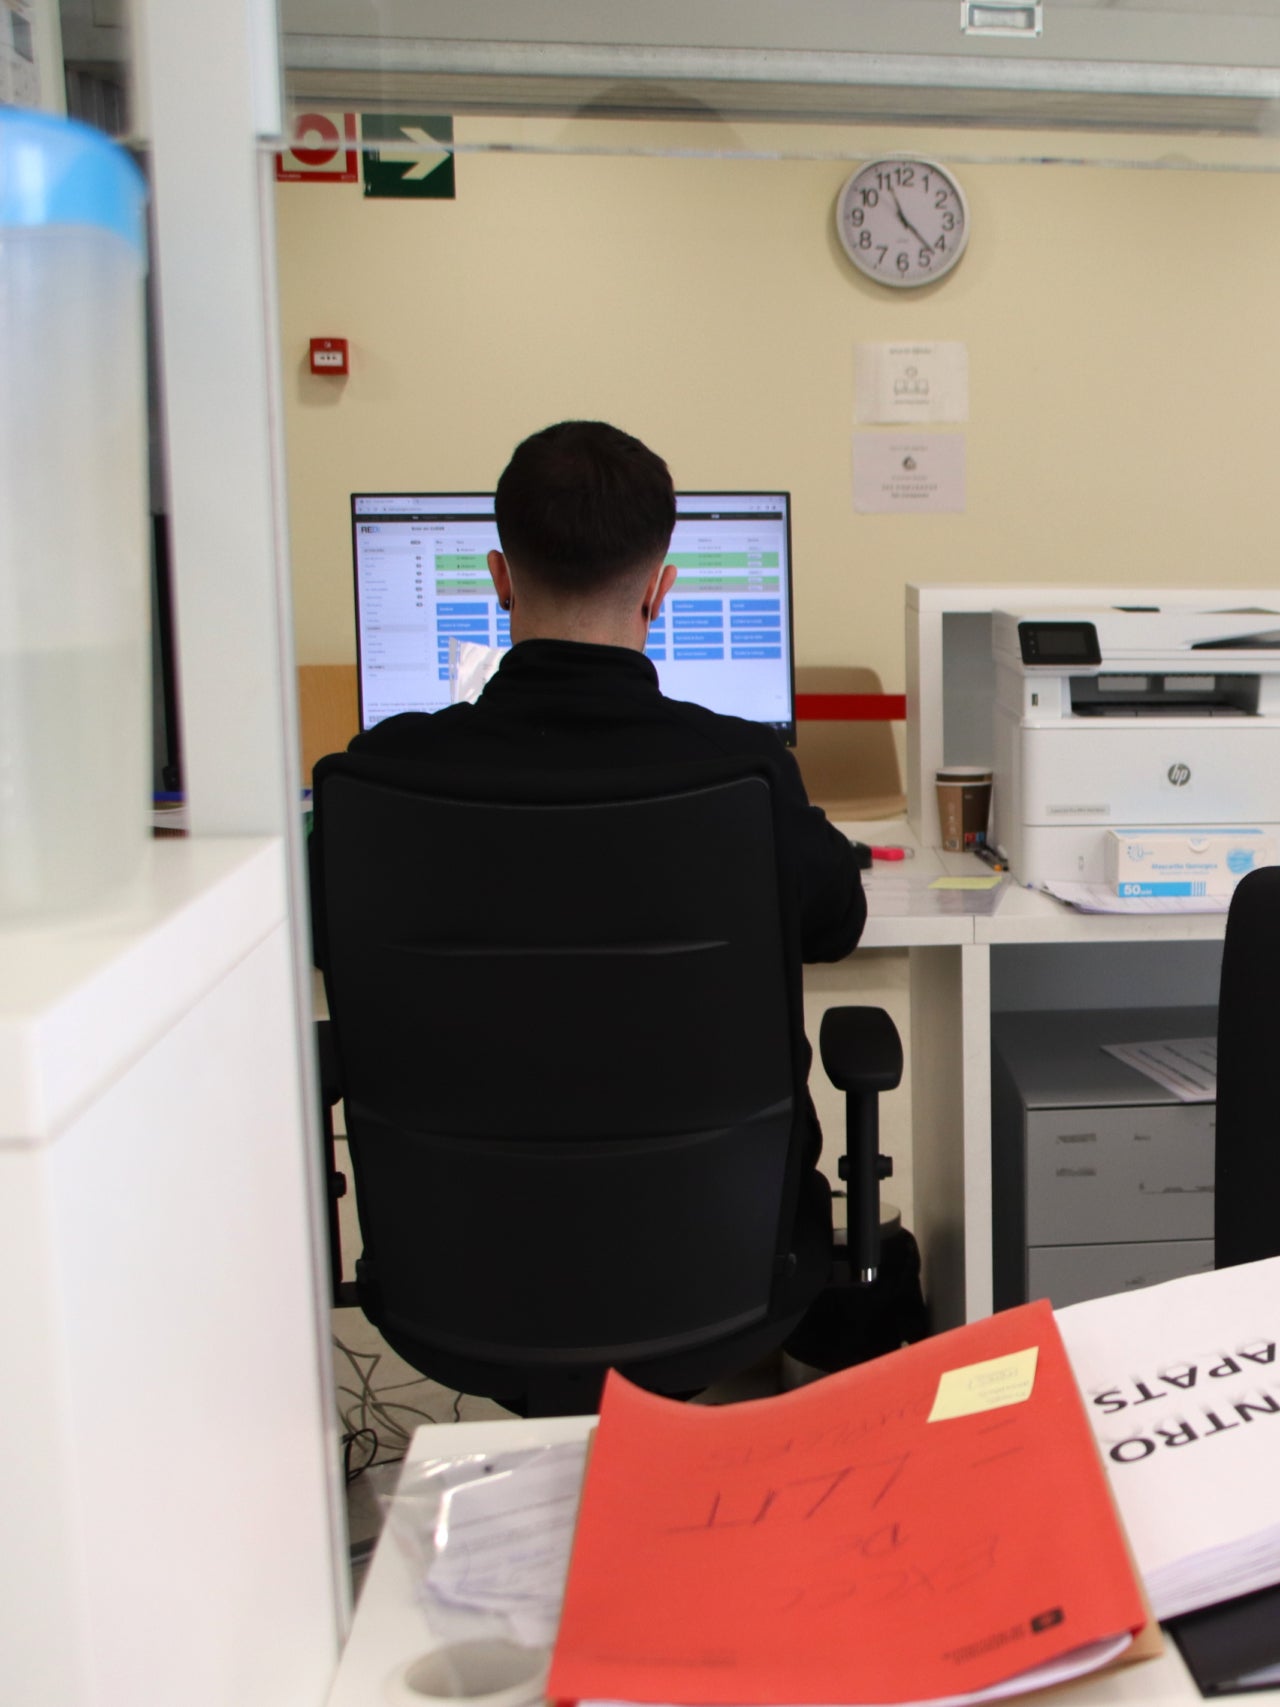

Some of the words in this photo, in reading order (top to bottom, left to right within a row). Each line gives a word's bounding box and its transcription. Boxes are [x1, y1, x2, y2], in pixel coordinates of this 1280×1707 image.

[876, 172, 891, 191] 11
[894, 167, 915, 187] 12
[922, 174, 930, 193] 1
[859, 188, 879, 208] 10
[935, 189, 948, 209] 2
[851, 208, 865, 228] 9
[941, 211, 955, 231] 3
[859, 230, 872, 250] 8
[934, 234, 946, 252] 4
[875, 245, 889, 264] 7
[896, 252, 910, 272] 6
[917, 247, 931, 268] 5
[1168, 763, 1191, 787] hp
[1123, 884, 1141, 895] 50
[1093, 1342, 1276, 1414] APATS
